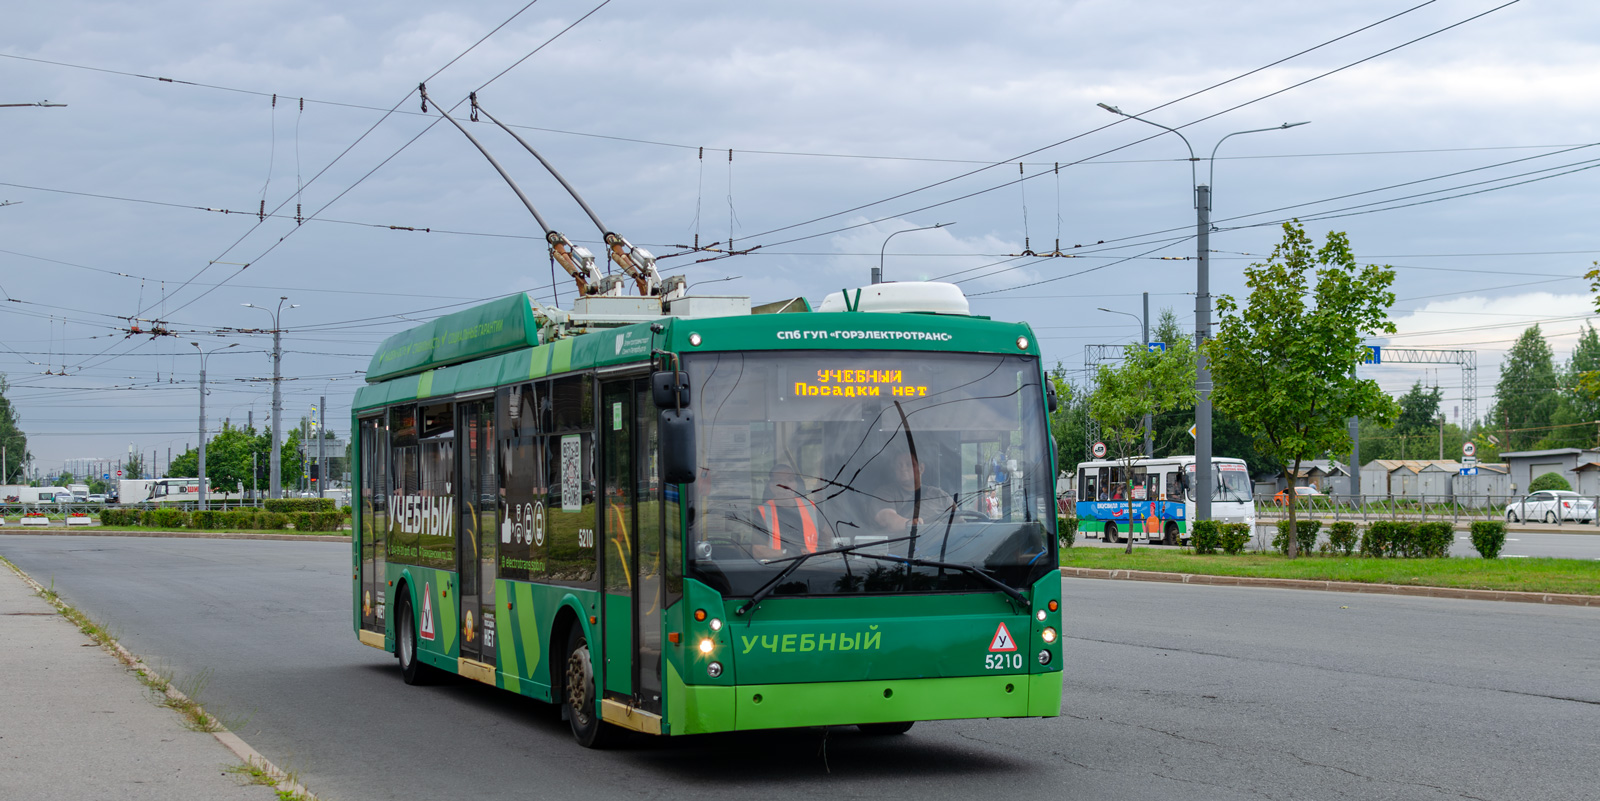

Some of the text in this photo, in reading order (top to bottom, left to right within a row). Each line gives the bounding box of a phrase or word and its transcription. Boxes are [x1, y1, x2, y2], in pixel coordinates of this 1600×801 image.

[803, 331, 828, 339] ГУП
[830, 330, 952, 341] «ГОРЭЛЕКТРОТРАНС»
[817, 369, 902, 383] УЧЕБНЫЙ
[795, 382, 927, 397] Посадки нет
[388, 482, 453, 537] УЧЕБНЫЙ
[578, 528, 593, 548] 5210
[425, 609, 430, 630] У
[484, 629, 495, 647] НЕТ
[741, 624, 882, 654] УЧЕБНЫЙ
[998, 635, 1007, 648] У
[985, 653, 1022, 669] 5210
